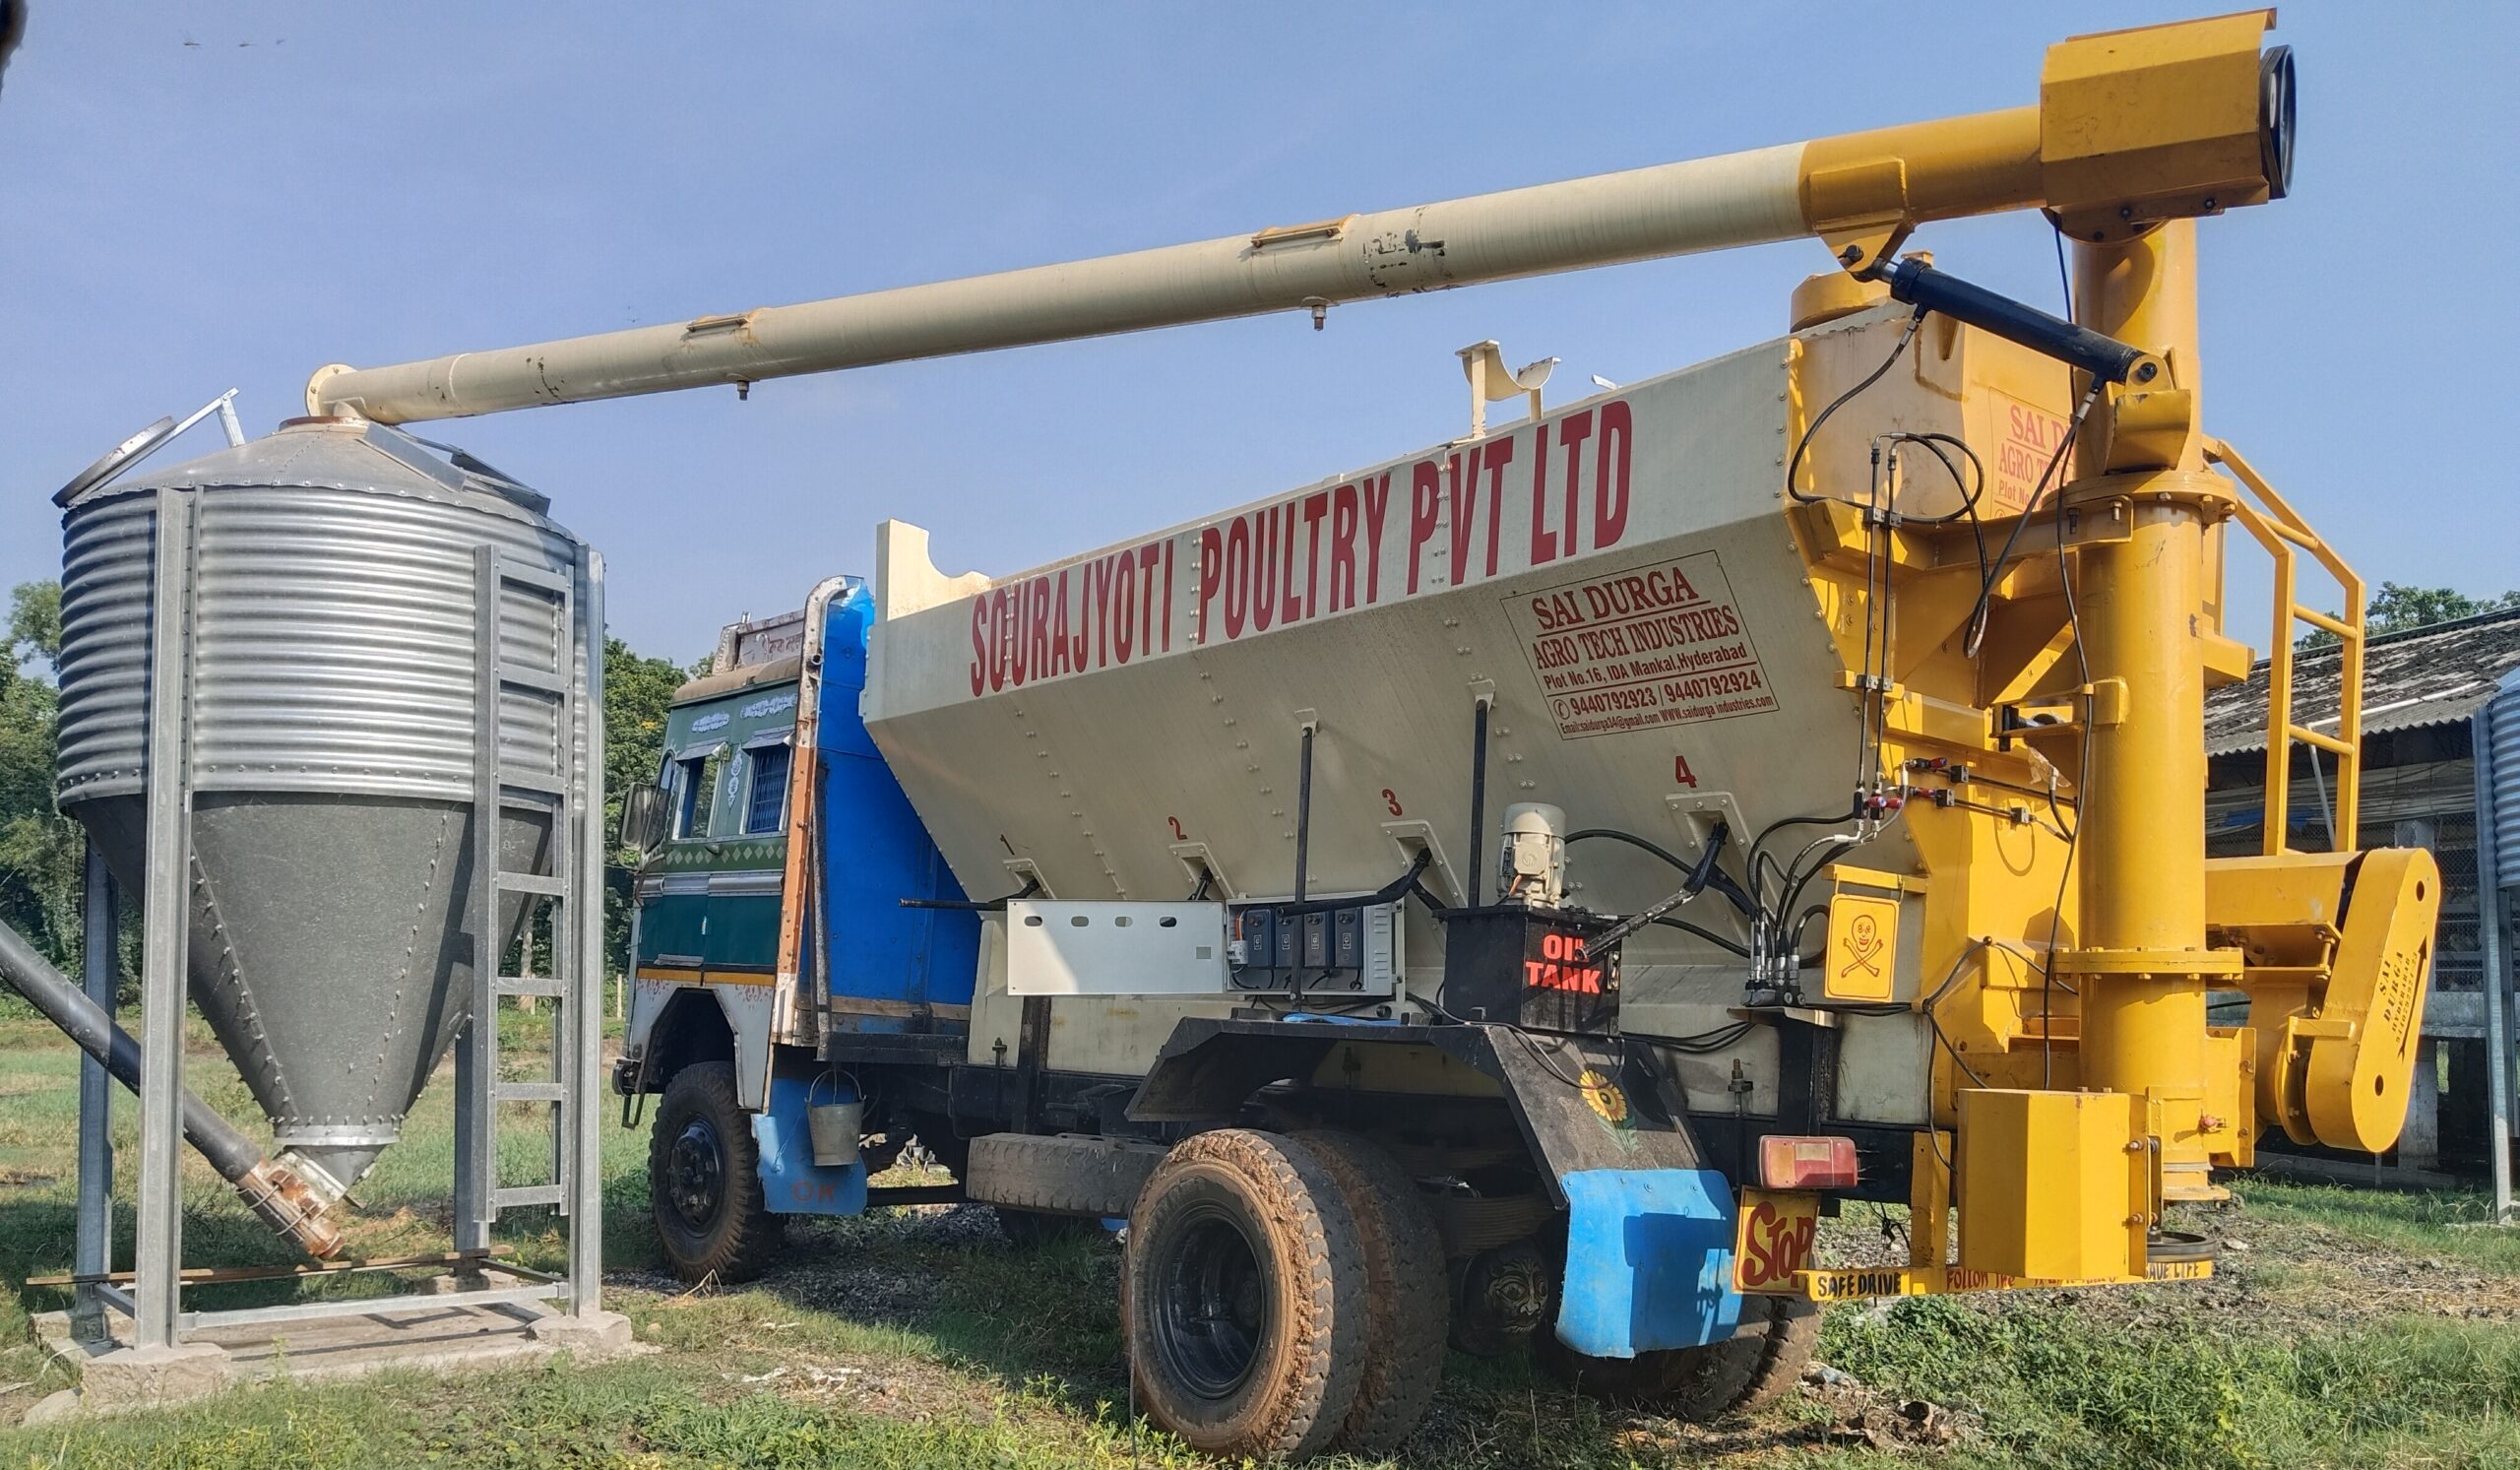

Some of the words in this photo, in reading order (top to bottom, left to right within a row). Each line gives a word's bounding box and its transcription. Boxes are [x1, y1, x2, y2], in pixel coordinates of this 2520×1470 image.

[2010, 404, 2046, 449] SAI
[1999, 443, 2034, 483] AGRO
[1999, 479, 2016, 501] Plot
[971, 539, 1172, 696] SOURAJYOTI
[1198, 474, 1391, 645] POULTRY
[1408, 436, 1513, 595] PVT
[1531, 400, 1632, 564] LTD
[1531, 590, 1585, 629] SAI
[1582, 566, 1699, 619] DURGA
[1532, 635, 1579, 670] AGRO
[1578, 626, 1630, 661] TECH
[1625, 605, 1739, 653] INDUSTRIES
[1543, 671, 1566, 690] Plot
[1606, 663, 1629, 680] IDA
[1569, 686, 1657, 716] 9440792923
[1665, 670, 1761, 702] 9440792924
[1674, 755, 1697, 788] 4
[1382, 789, 1403, 816] 3
[1167, 816, 1187, 840] 2
[1544, 933, 1590, 963] OIL
[1525, 961, 1602, 994] TANK
[2379, 959, 2391, 995] SAI
[2383, 951, 2404, 1023] DURGA
[1818, 1275, 1856, 1297] SAFE
[1858, 1273, 1902, 1296] DRIVE
